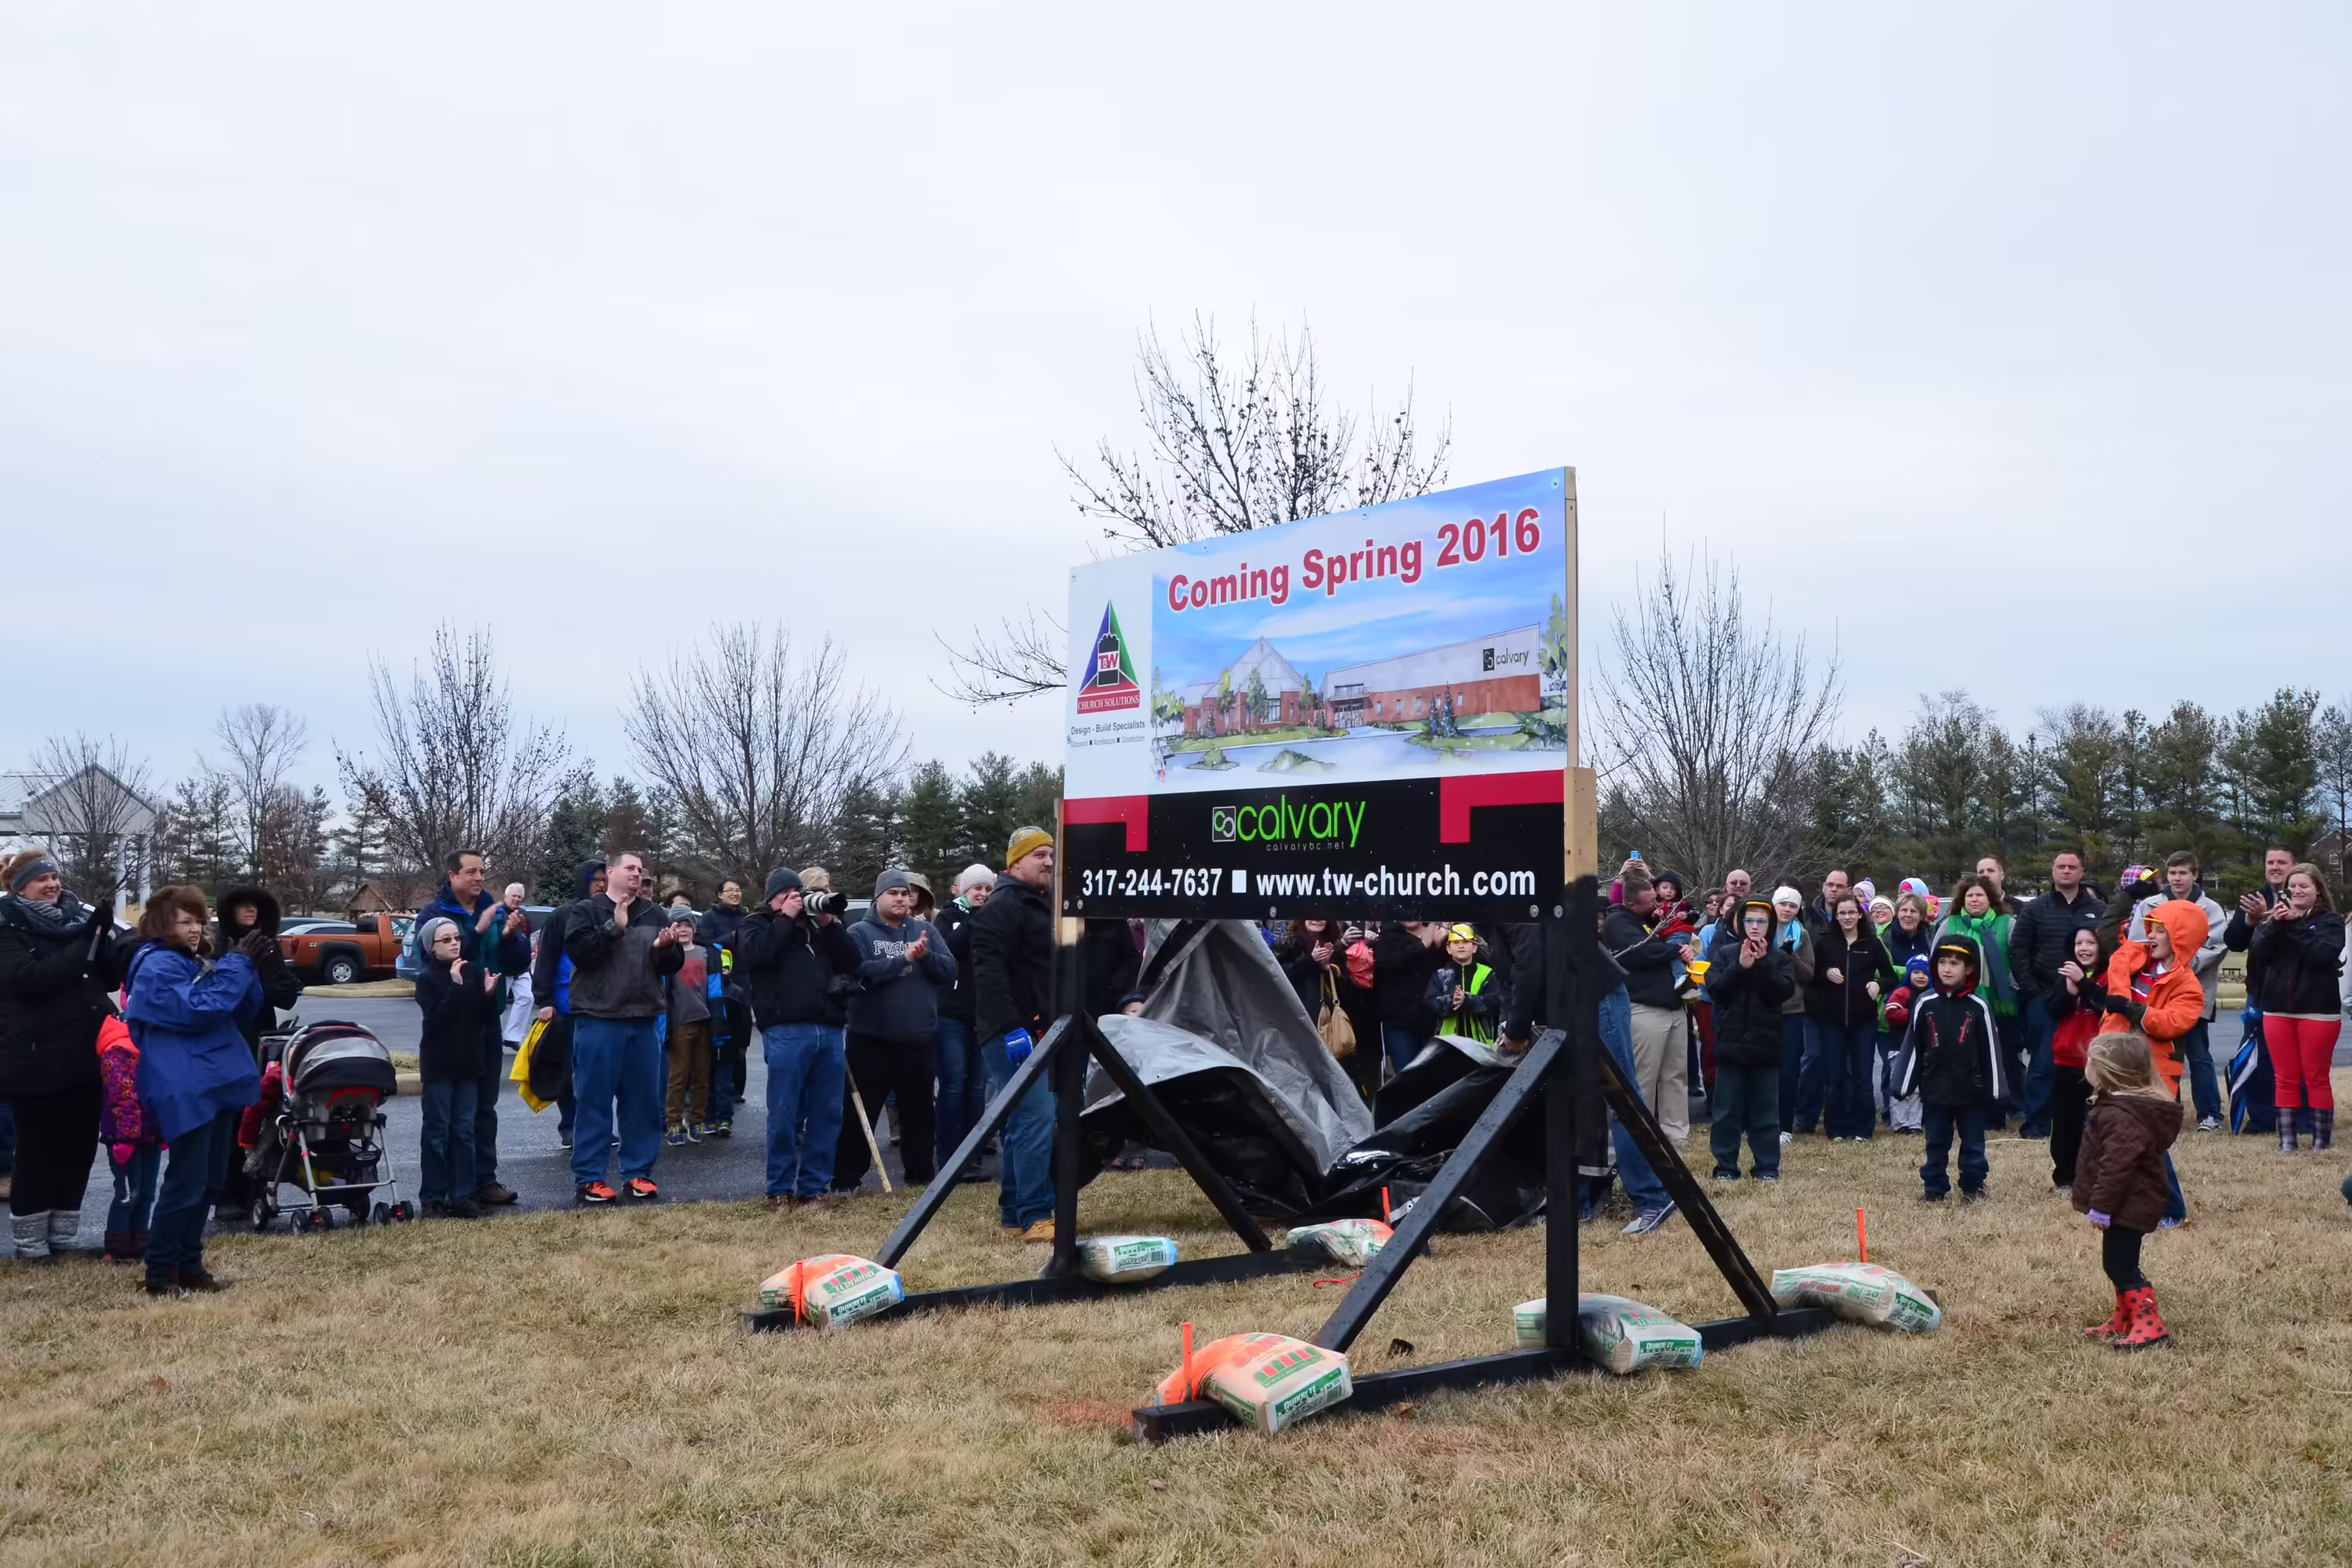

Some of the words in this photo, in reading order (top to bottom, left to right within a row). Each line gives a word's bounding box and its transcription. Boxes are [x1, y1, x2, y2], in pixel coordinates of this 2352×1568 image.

[1169, 563, 1289, 612] Coming
[1302, 539, 1422, 596] Spring
[1437, 508, 1541, 567] 2016
[1496, 647, 1529, 667] calvary
[1078, 699, 1103, 710] CHURCH
[1104, 695, 1139, 707] SOLUTIONS
[1071, 726, 1091, 735] Design
[1095, 723, 1111, 733] Build
[1112, 720, 1145, 733] Specialists
[1236, 794, 1366, 848] calvary
[1266, 841, 1345, 852] calvarybc.net
[1082, 868, 1222, 897] 317-244-7637
[1256, 864, 1536, 897] www.tw-church.com
[873, 940, 909, 956] PUR
